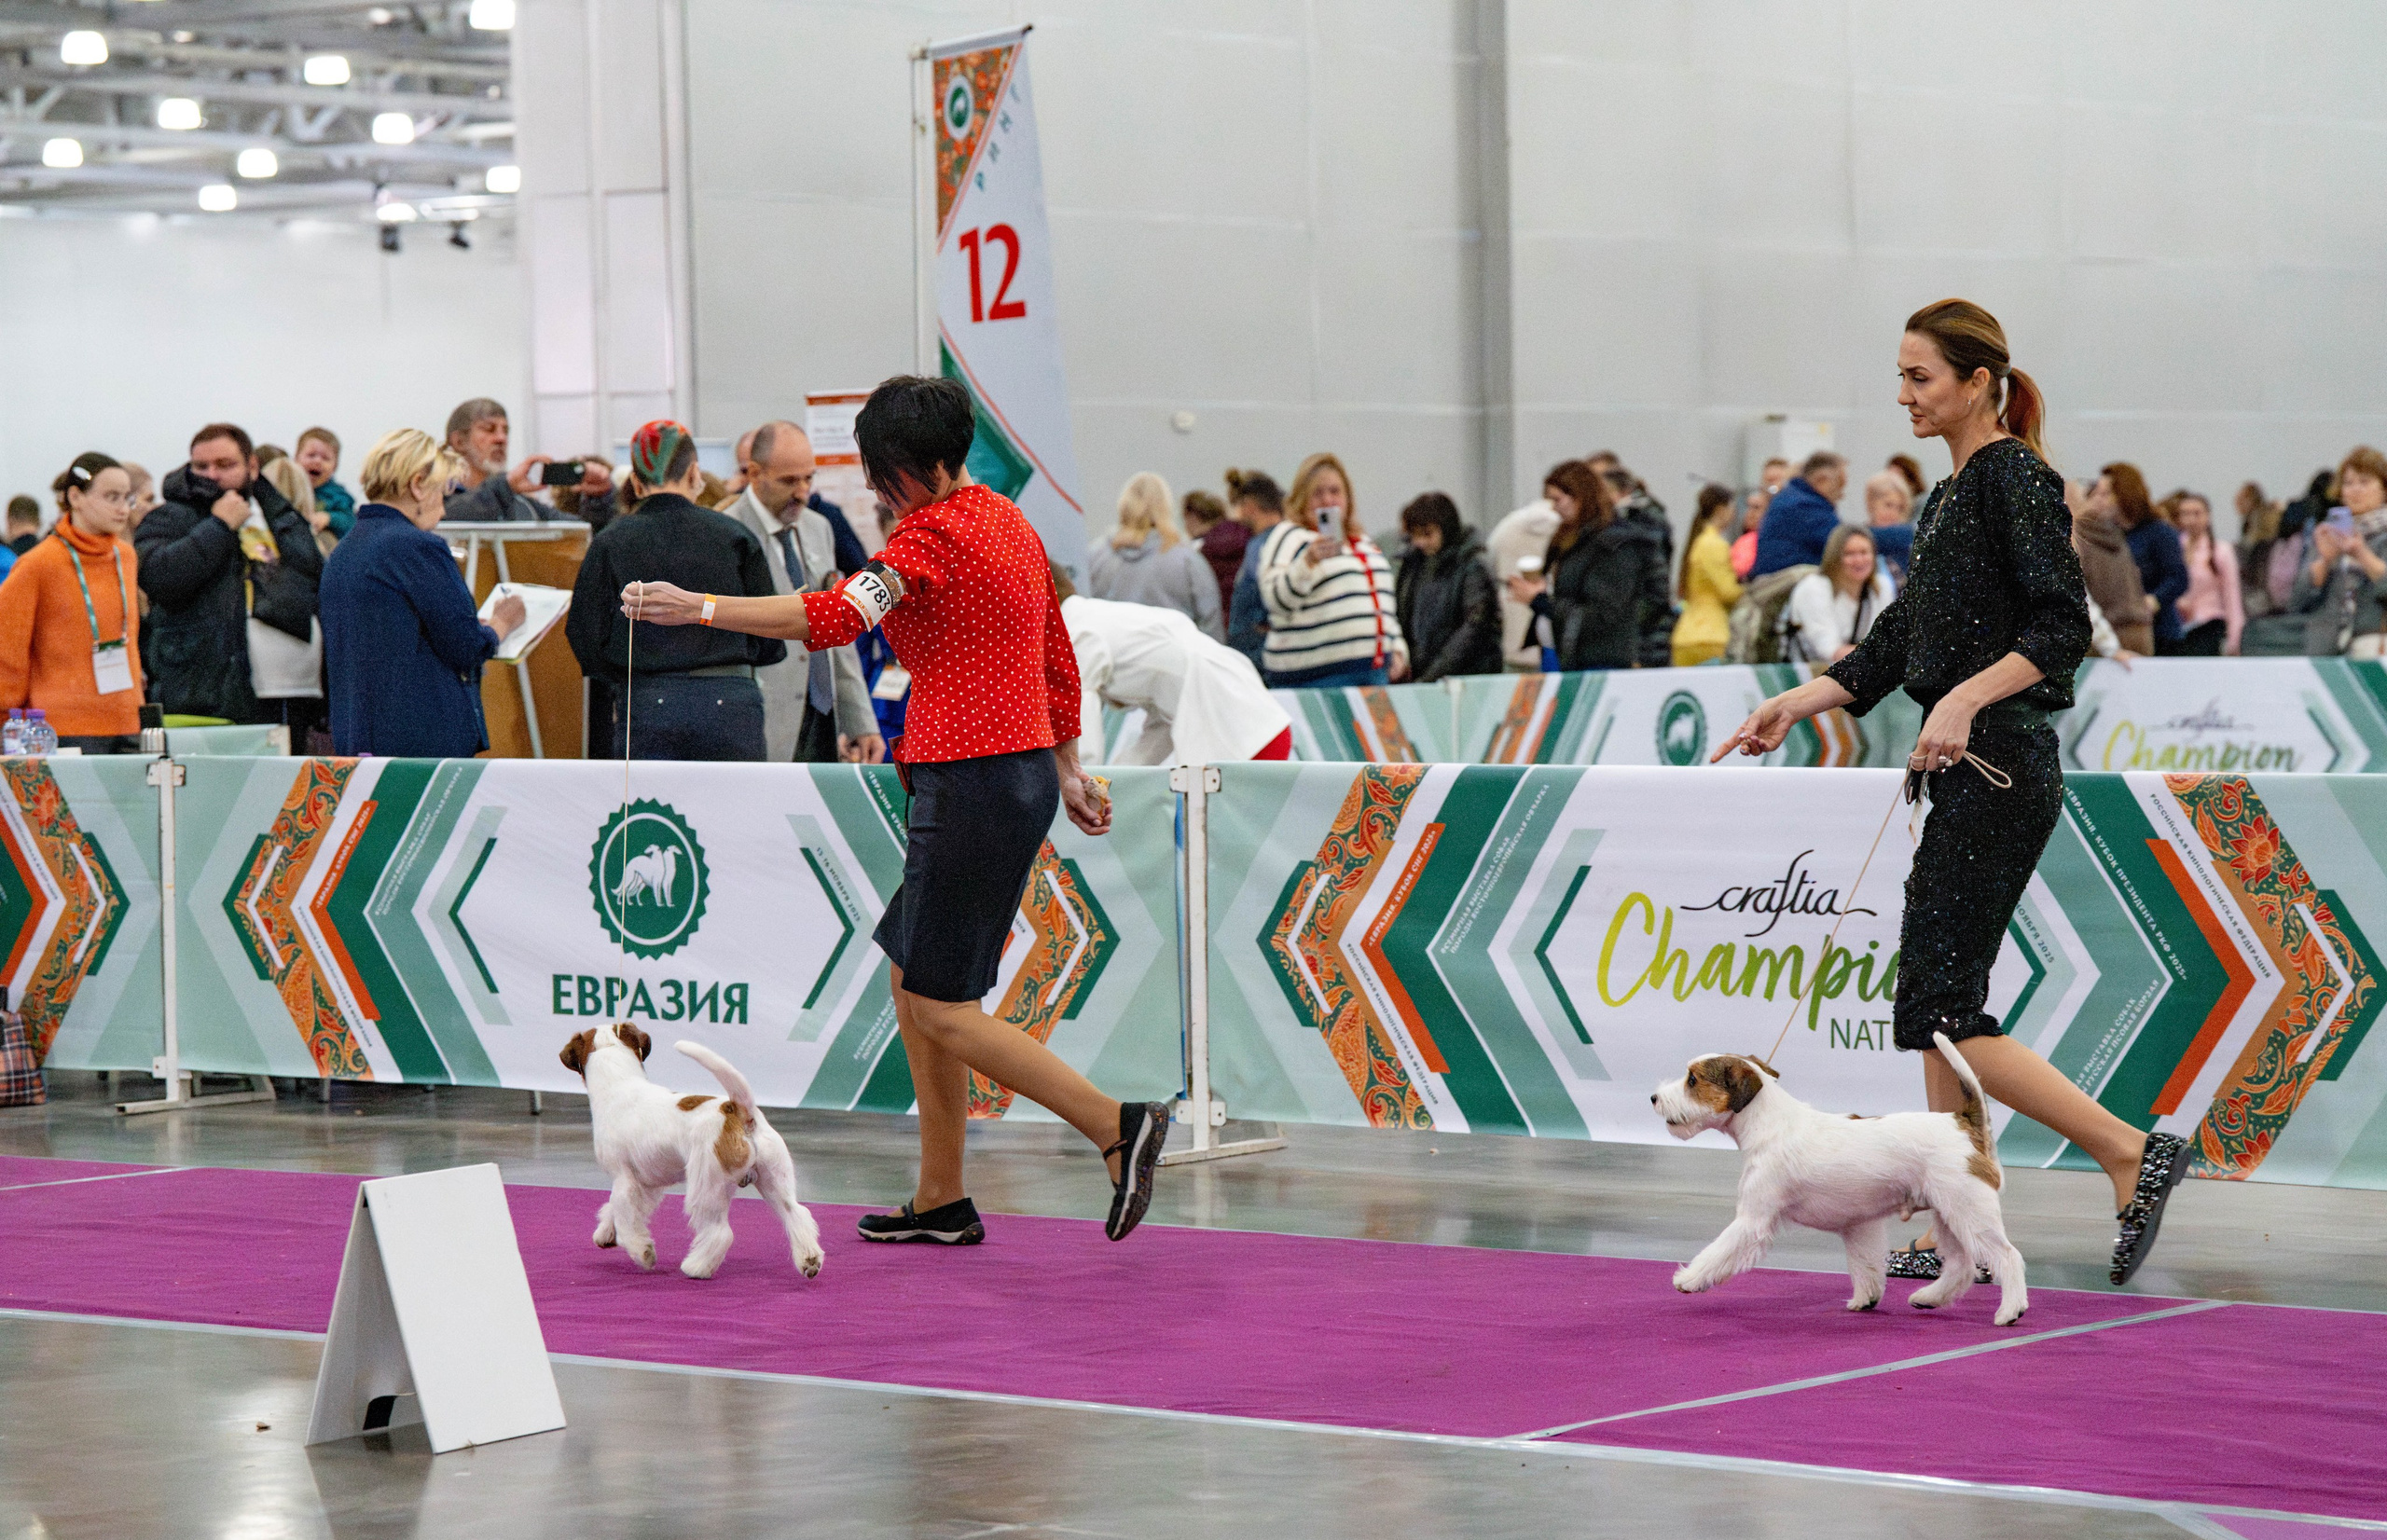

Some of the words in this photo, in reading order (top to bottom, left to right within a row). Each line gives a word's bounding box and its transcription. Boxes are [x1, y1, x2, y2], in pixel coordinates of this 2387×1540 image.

[959, 223, 1027, 323] 12
[859, 575, 890, 612] 1783
[1524, 782, 1550, 821] ОВЧАРКА
[1392, 872, 1414, 902] КУБОК
[1410, 854, 1424, 873] СНГ
[1468, 862, 1496, 907] ВЫСТАВКА
[1680, 849, 1878, 937] craftia
[2063, 784, 2099, 836] «ЕВРАЗИЯ.
[2093, 834, 2119, 869] КУБОК
[2115, 867, 2159, 931] ПРЕЗИДЕНТА
[2154, 930, 2172, 953] РКФ
[2167, 952, 2189, 982] 2025»
[2148, 792, 2189, 850] РОССИЙСКАЯ
[2185, 848, 2239, 928] КИНОЛОГИЧЕСКАЯ
[2235, 927, 2271, 979] ФЕДЕРАЦИЯ
[2036, 939, 2055, 964] 2025
[552, 973, 749, 1024] ЕВРАЗИЯ
[1830, 1018, 1895, 1052] NAT
[2082, 1025, 2117, 1073] ВЫСТАВКА
[2113, 996, 2136, 1026] СОБАК
[2084, 1046, 2114, 1087] РУССКАЯ
[2110, 1011, 2138, 1048] ПСОВАЯ
[2133, 978, 2159, 1012] БОРЗАЯ
[1412, 1060, 1439, 1106] ФЕДЕРАЦИЯ
